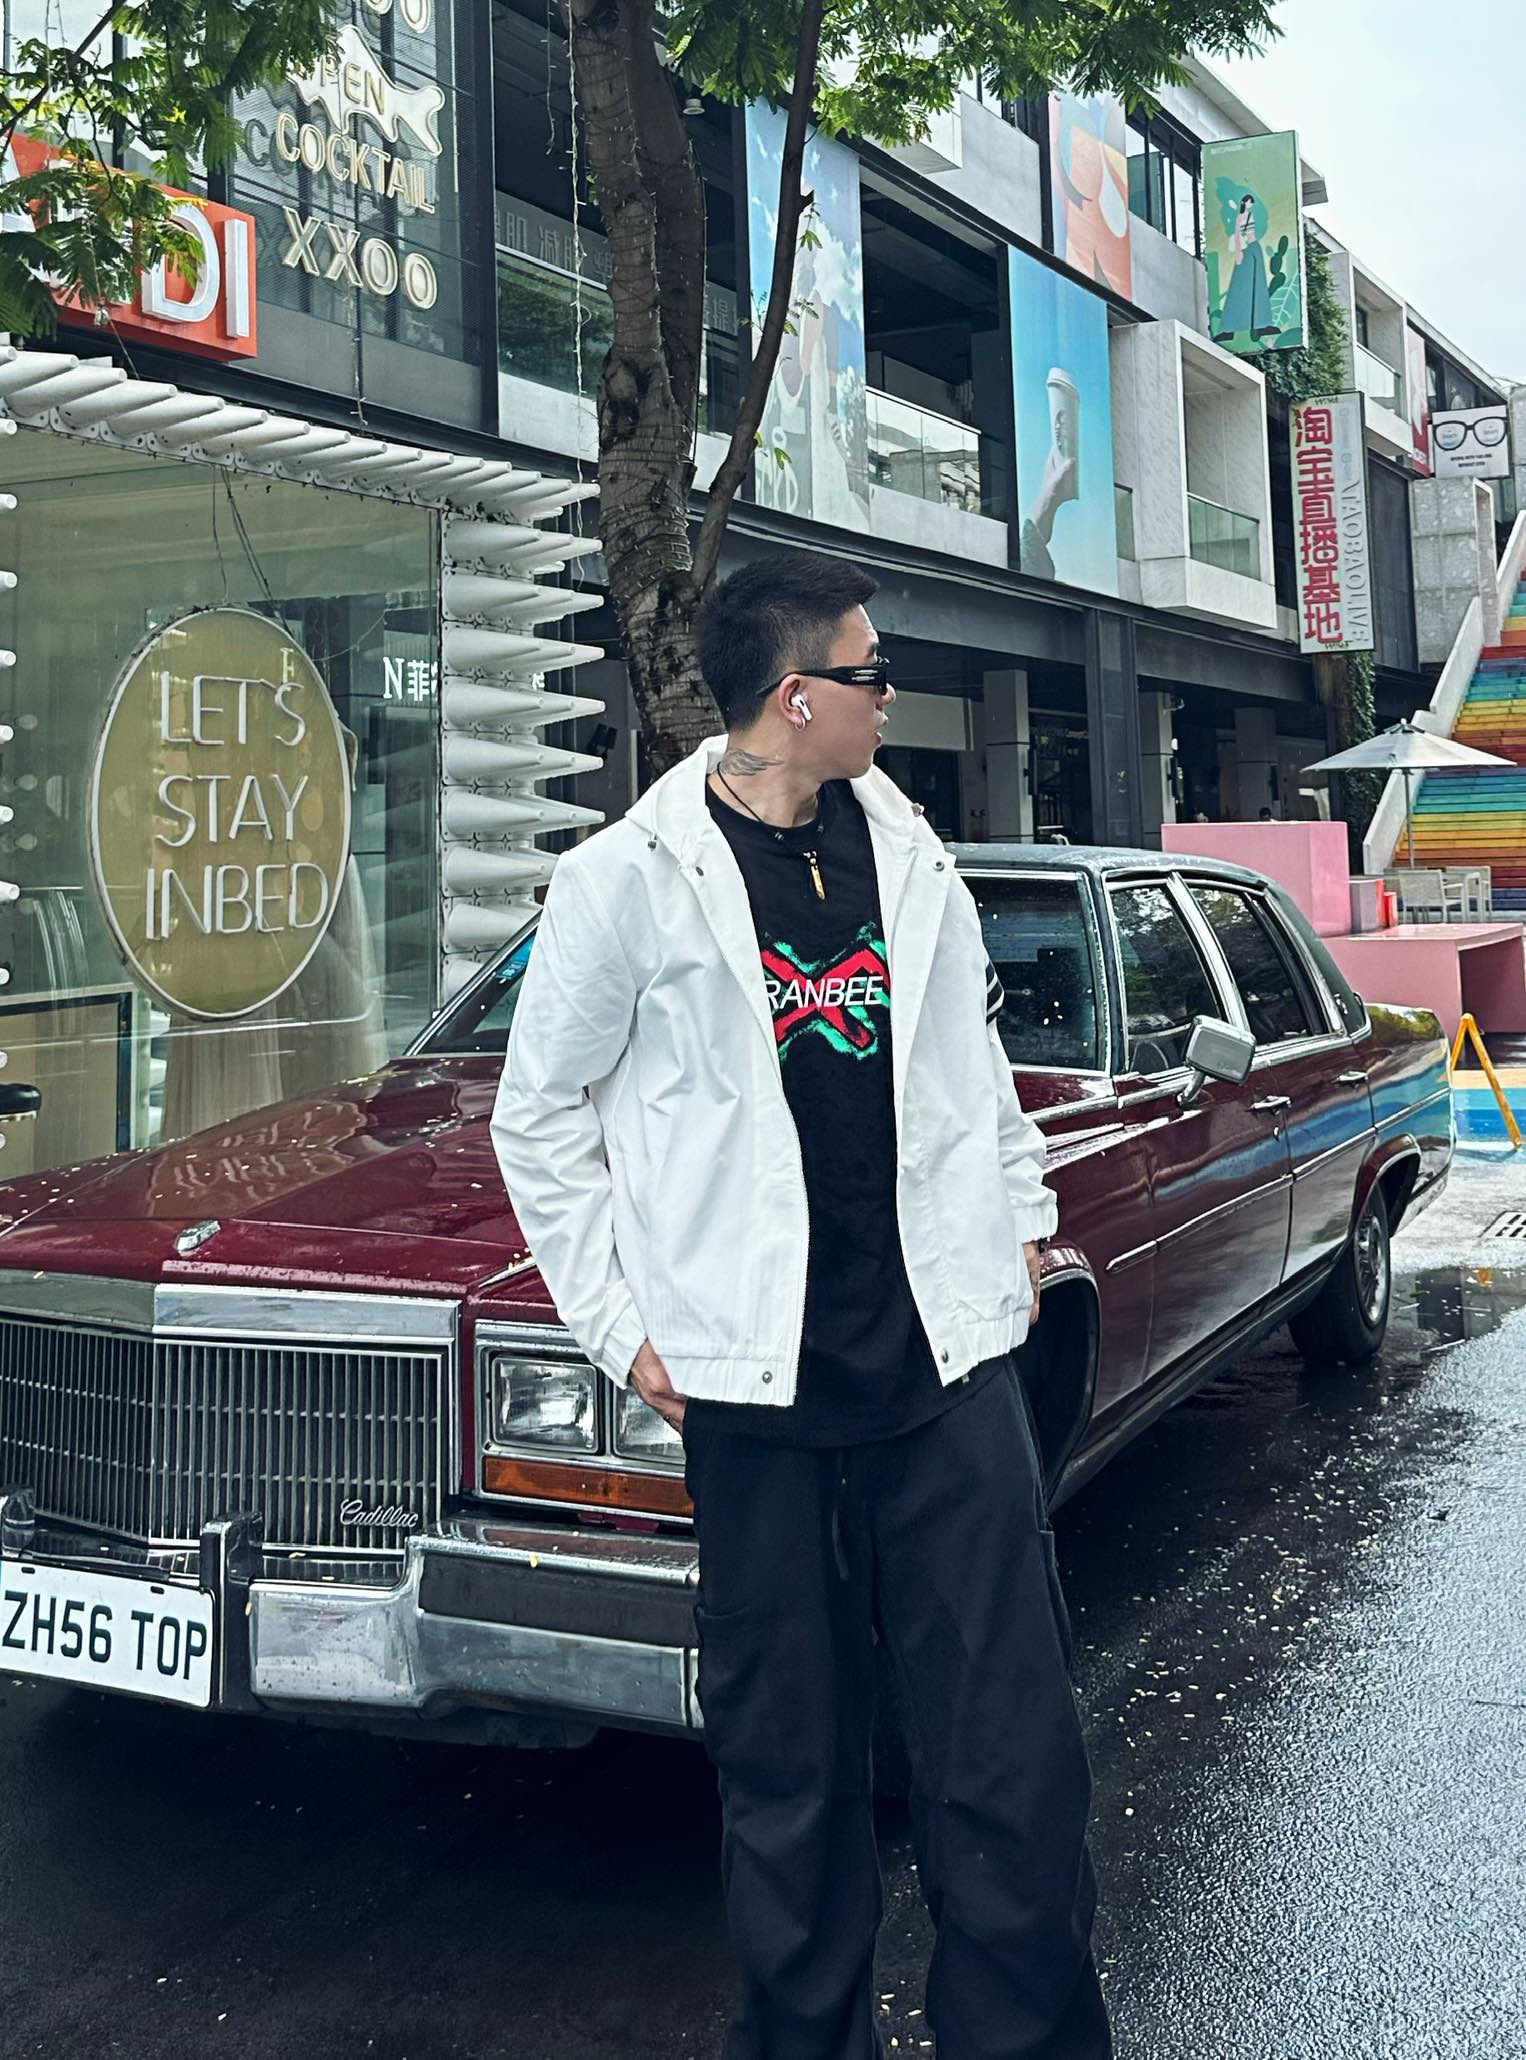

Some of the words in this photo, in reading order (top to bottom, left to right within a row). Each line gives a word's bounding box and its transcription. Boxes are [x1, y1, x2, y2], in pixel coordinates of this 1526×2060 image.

[318, 53, 385, 116] PEN
[275, 112, 436, 215] COCKTAIL
[281, 204, 438, 310] XXOO
[1295, 405, 1343, 645] 淘宝直播基地
[157, 774, 309, 847] STAY
[340, 1498, 419, 1528] Cadillac
[2, 1588, 113, 1664] ZH56
[130, 1609, 208, 1681] TOP
